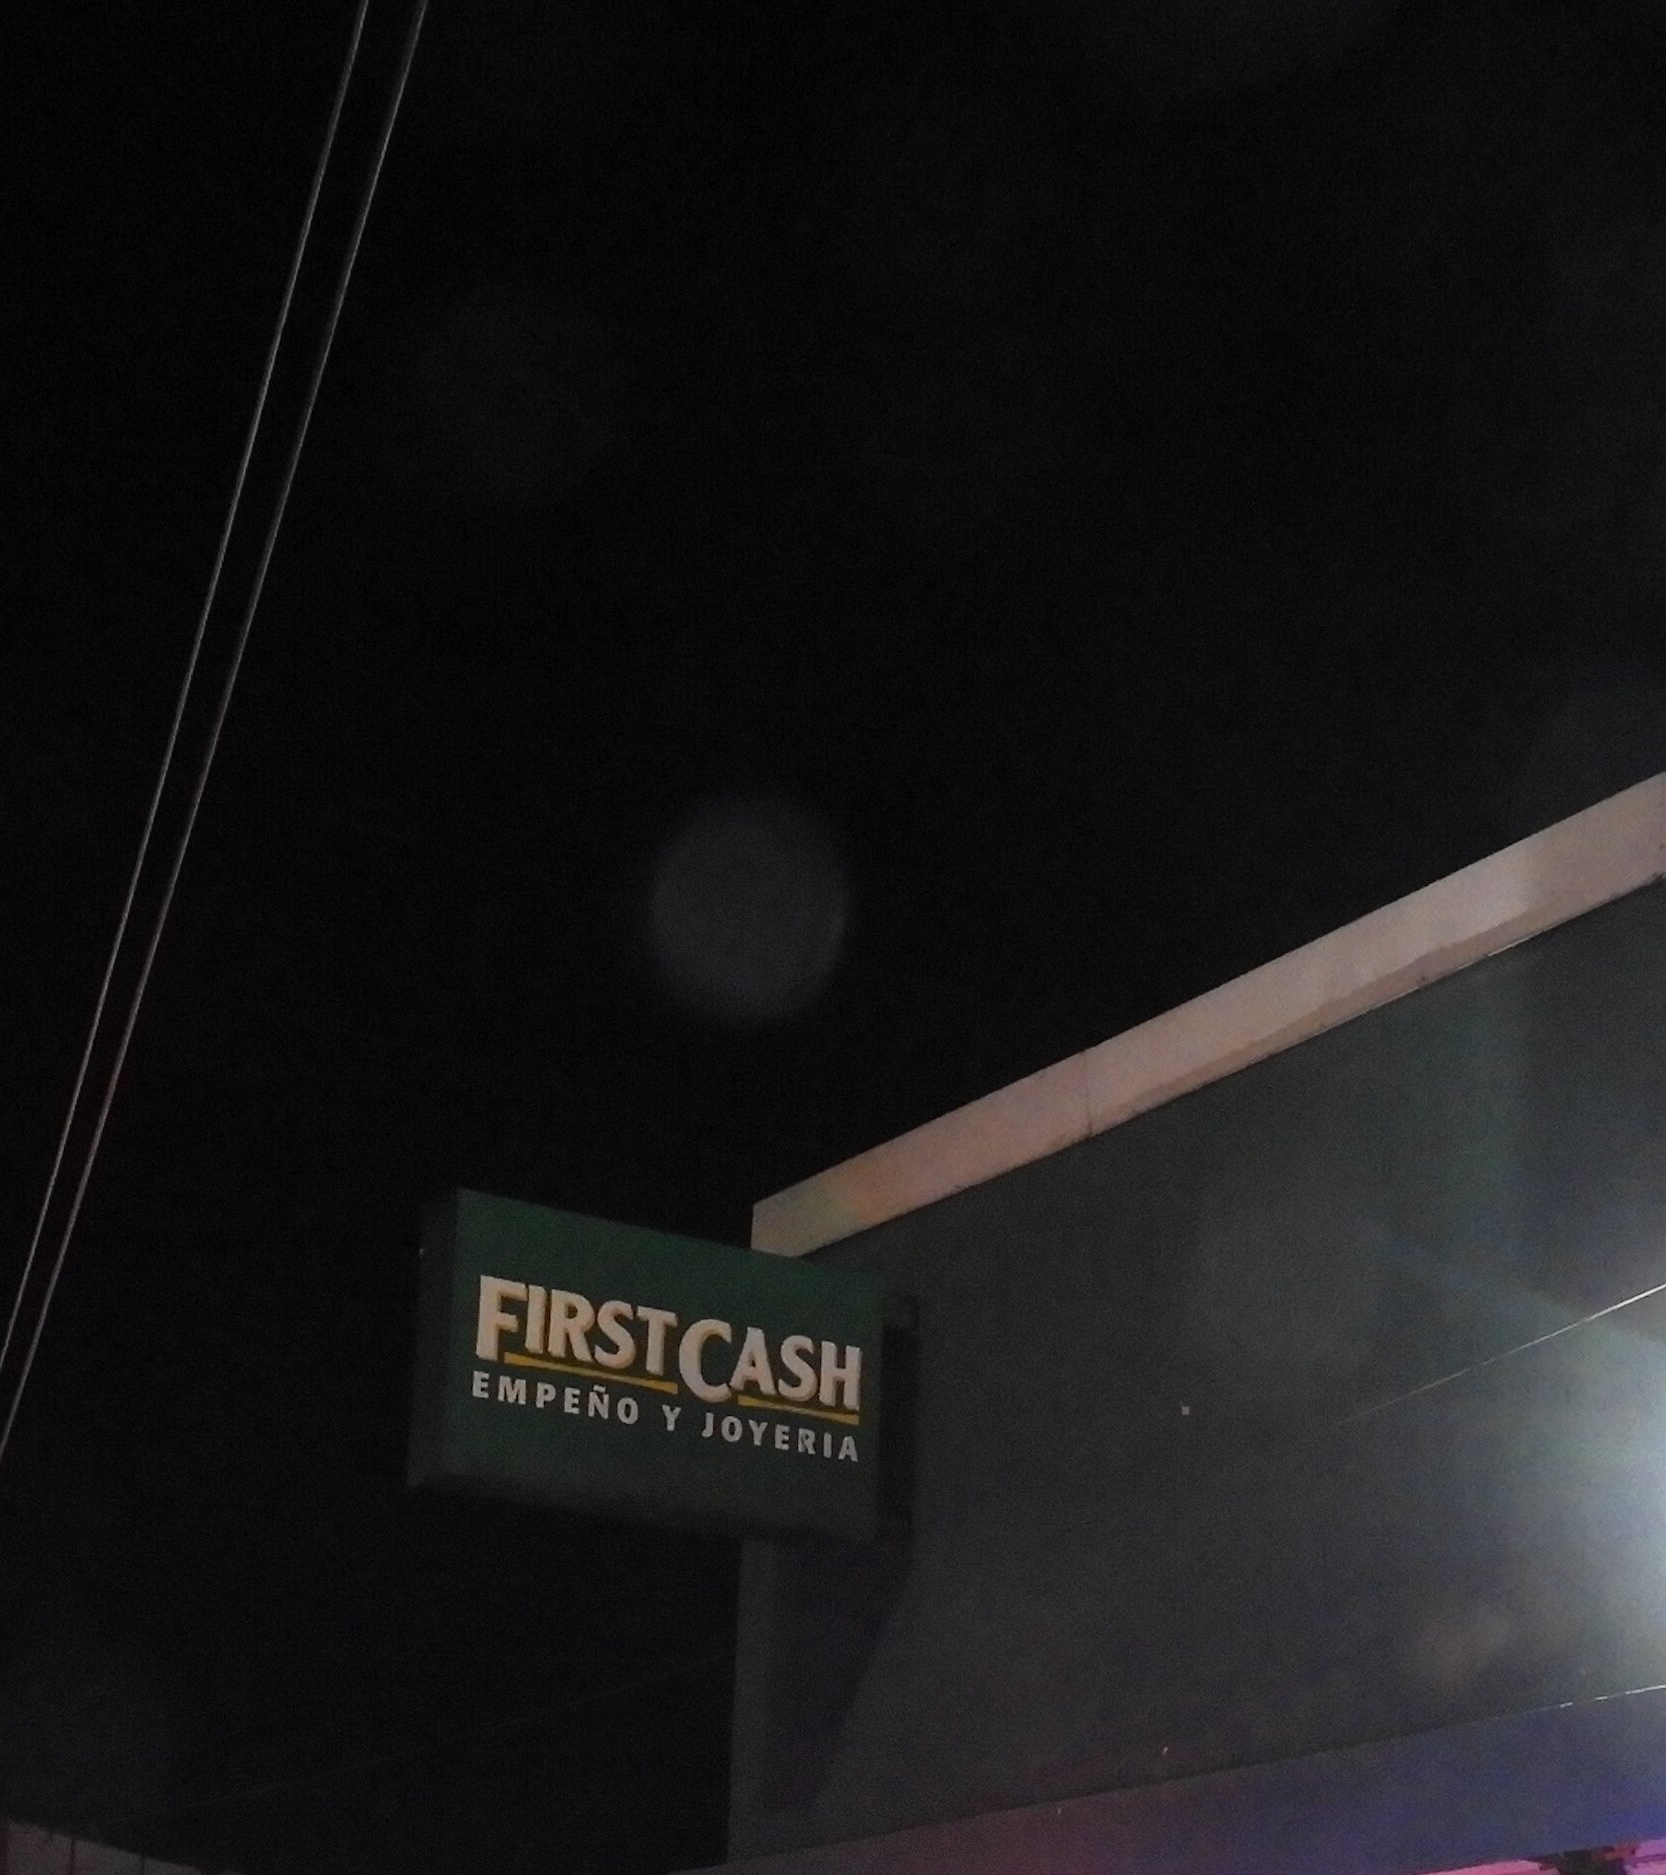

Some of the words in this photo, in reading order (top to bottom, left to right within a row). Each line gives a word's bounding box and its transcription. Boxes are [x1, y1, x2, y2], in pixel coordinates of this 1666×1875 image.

[475, 1275, 863, 1412] FIRSTCASH
[472, 1370, 639, 1425] EMPEÑO
[662, 1405, 683, 1431] Y
[701, 1412, 859, 1463] JOYERIA
